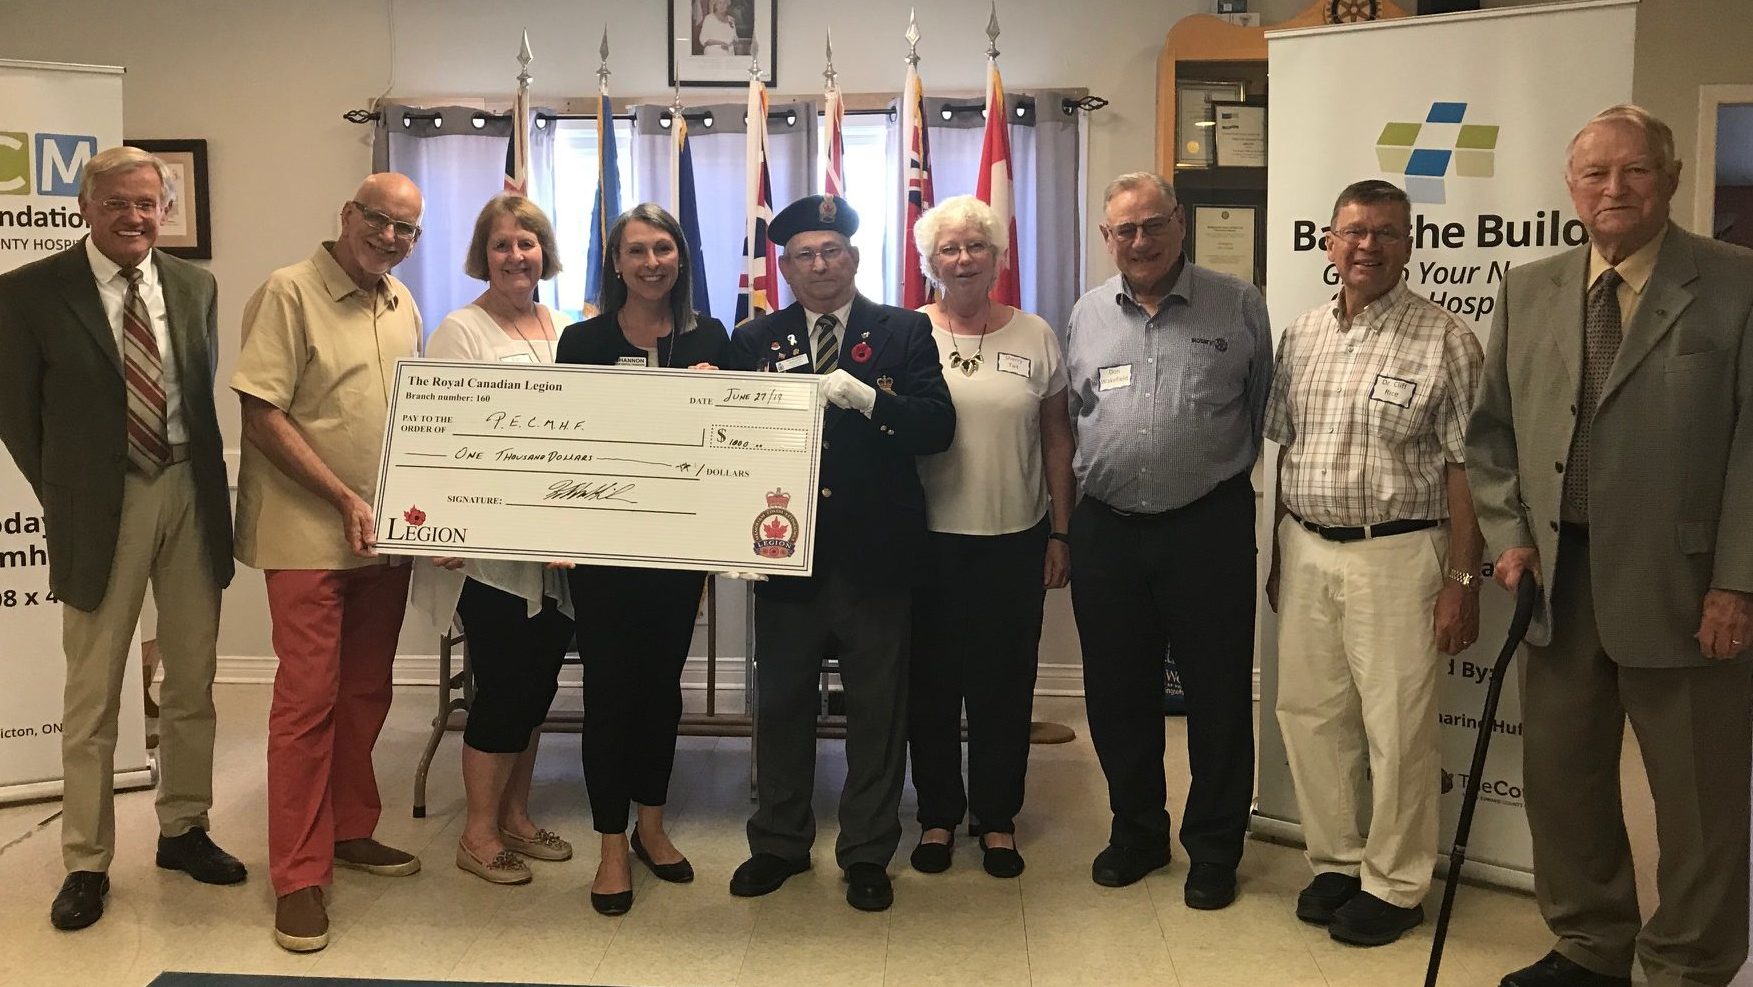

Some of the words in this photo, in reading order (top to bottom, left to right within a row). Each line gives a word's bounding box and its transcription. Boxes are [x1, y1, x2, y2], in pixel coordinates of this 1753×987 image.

[1411, 214, 1465, 249] he
[1, 239, 29, 250] NTY
[1420, 262, 1480, 285] Your
[408, 376, 429, 387] The
[432, 377, 464, 389] Royal
[467, 378, 521, 390] Canadian
[525, 381, 563, 393] Legion
[406, 392, 436, 400] Branch
[437, 394, 474, 402] number:
[689, 397, 713, 405] DATE
[402, 414, 419, 422] PAY
[421, 415, 433, 423] TO
[401, 425, 432, 433] ORDER
[434, 426, 447, 434] OF
[717, 428, 727, 443] $
[706, 468, 750, 478] DOLLARS
[447, 495, 503, 505] SIGNATURE:
[757, 539, 792, 549] LEGION
[0, 589, 17, 607] 8
[25, 592, 39, 606] x
[42, 723, 63, 734] ON
[1457, 773, 1523, 798] TeCo
